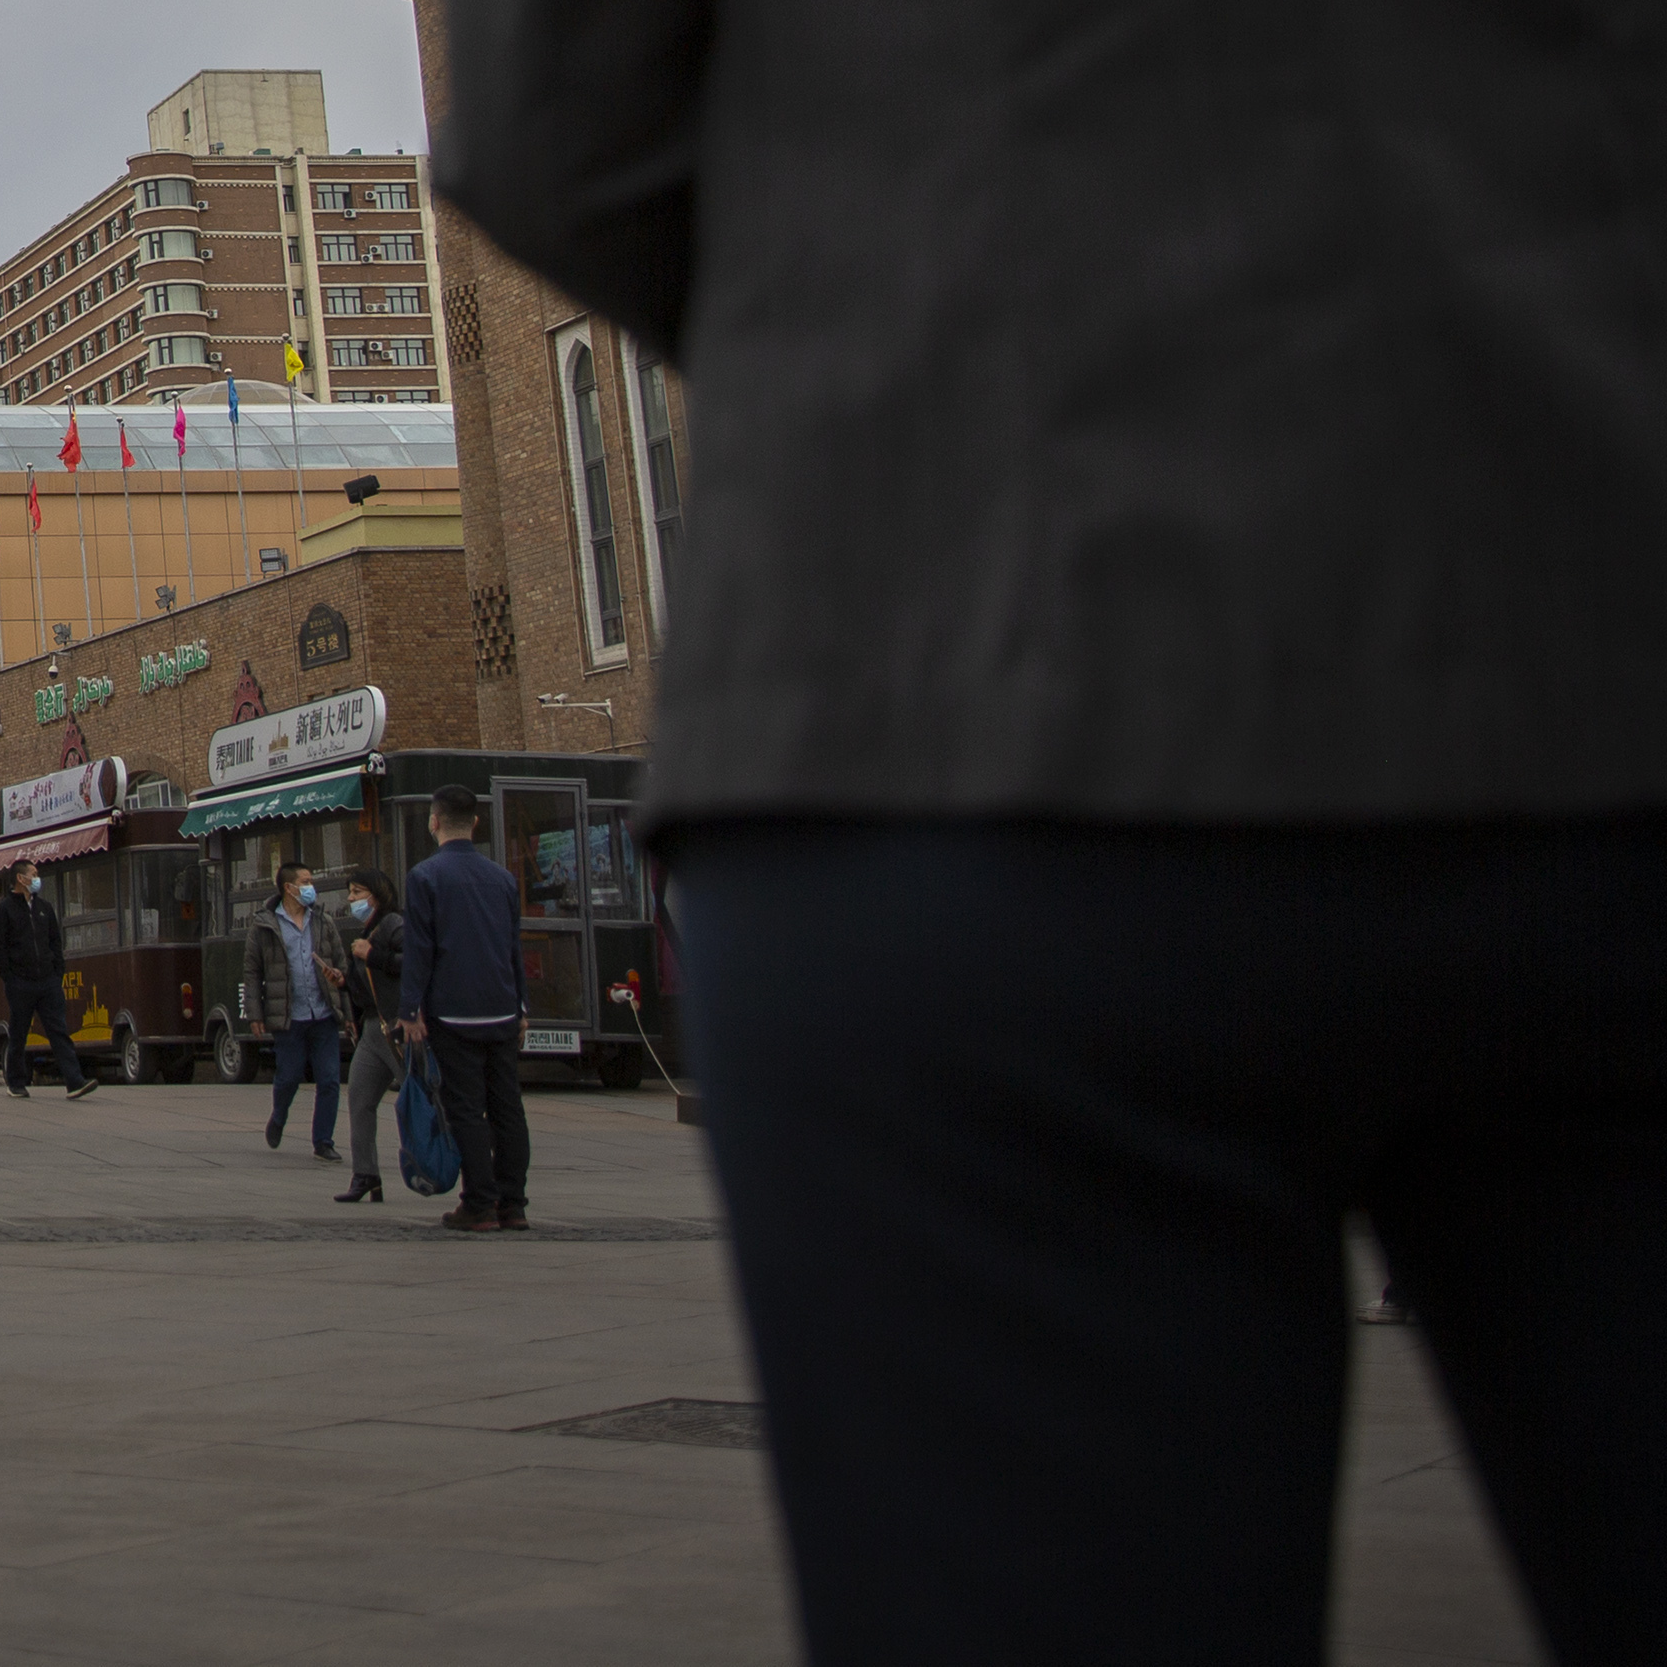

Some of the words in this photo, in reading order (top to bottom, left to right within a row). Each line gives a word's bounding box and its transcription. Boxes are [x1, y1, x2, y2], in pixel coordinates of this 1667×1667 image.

[306, 632, 340, 658] 5号楼
[295, 695, 364, 747] 新疆大列巴
